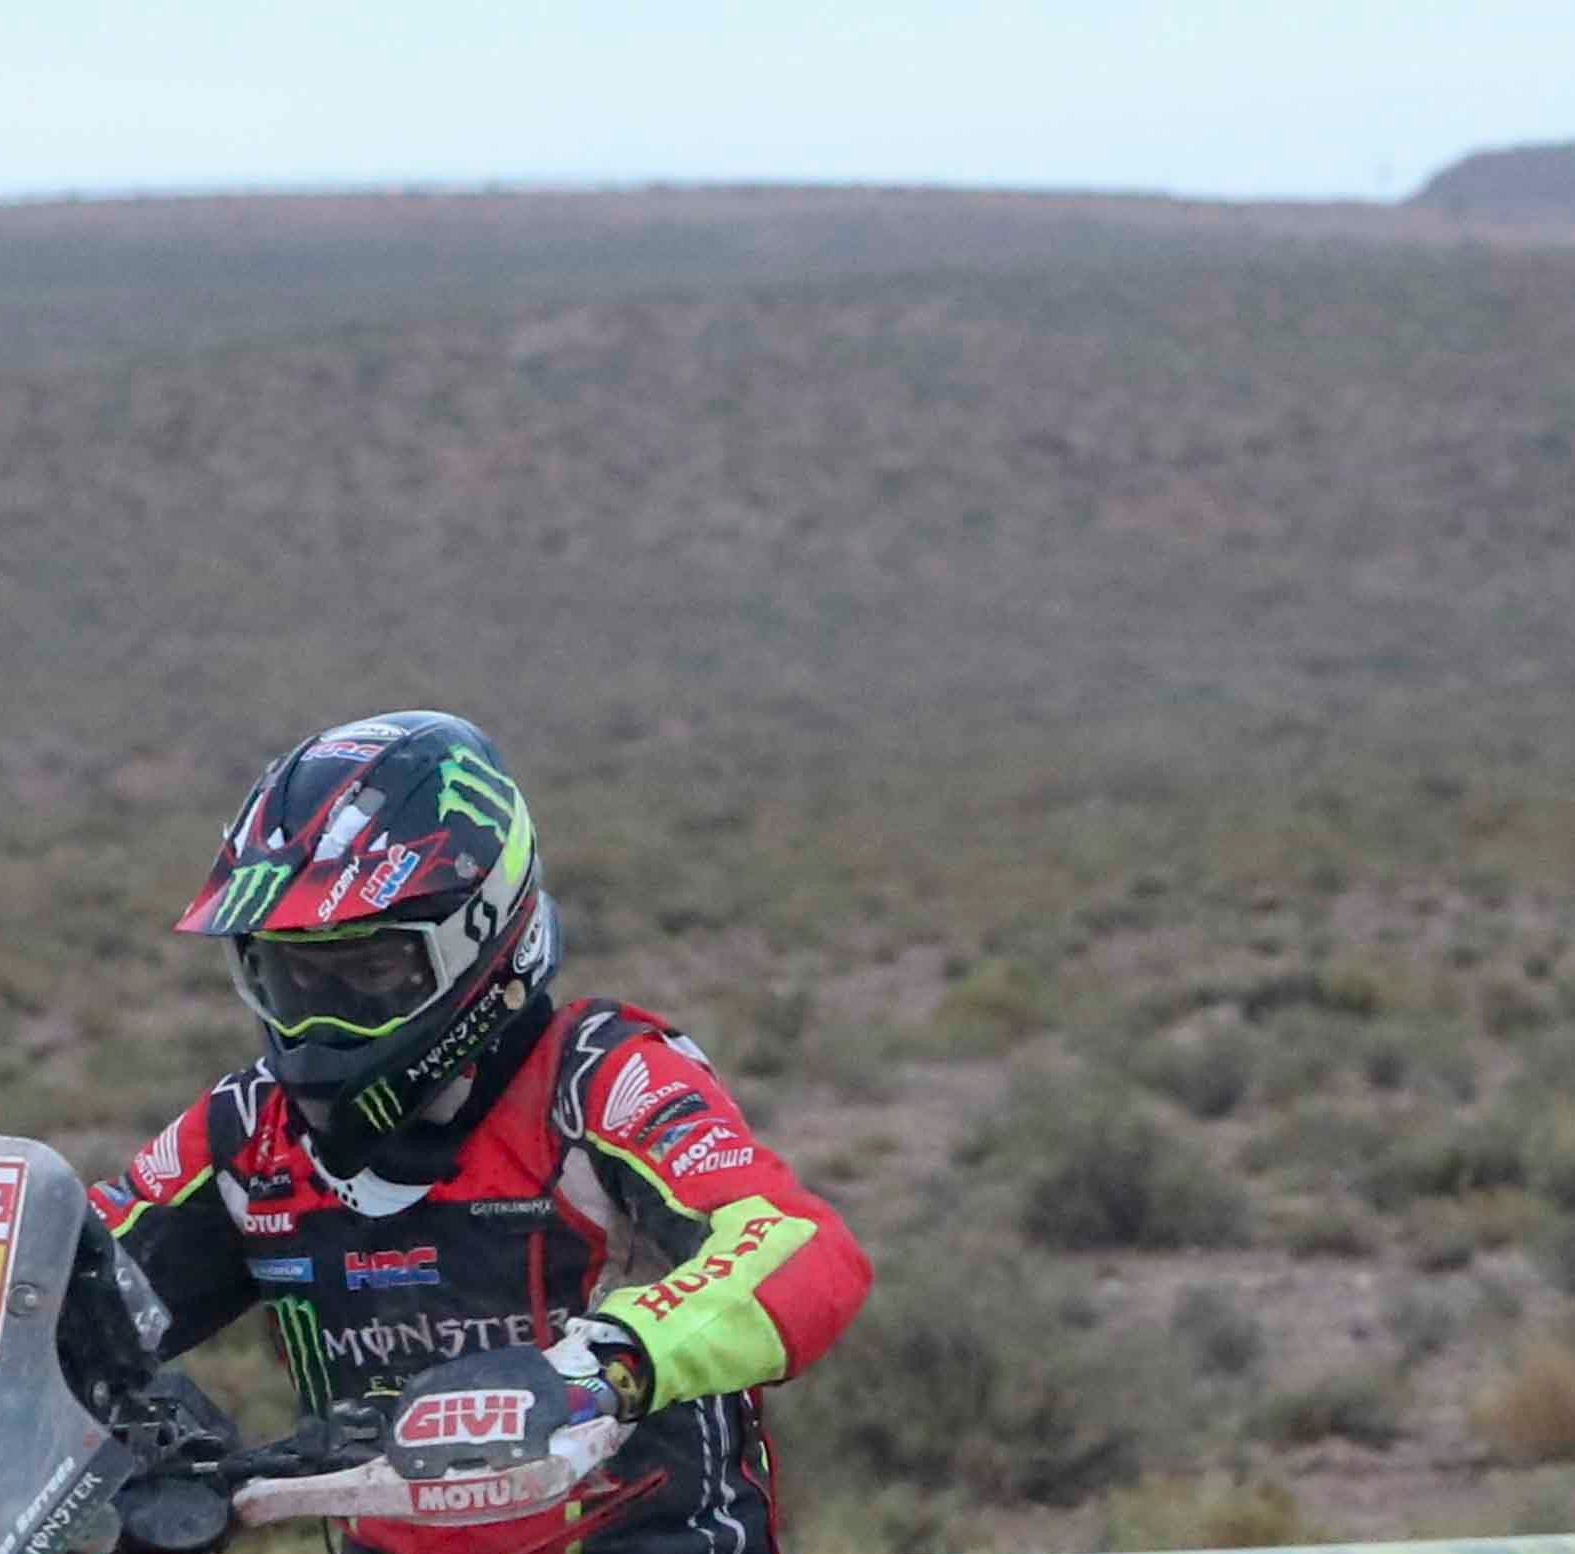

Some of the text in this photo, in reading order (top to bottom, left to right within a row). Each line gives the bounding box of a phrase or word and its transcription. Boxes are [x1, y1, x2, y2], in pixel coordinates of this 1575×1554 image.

[360, 844, 421, 909] HRC
[406, 983, 504, 1081] MONSTER
[618, 1081, 690, 1138] HONDA
[691, 1147, 754, 1174] OWA
[243, 1213, 293, 1233] OTUL
[345, 1246, 441, 1291] HRC
[322, 1307, 569, 1366] MONSTER
[400, 1394, 519, 1441] GIVI
[417, 1478, 530, 1511] MOTUL
